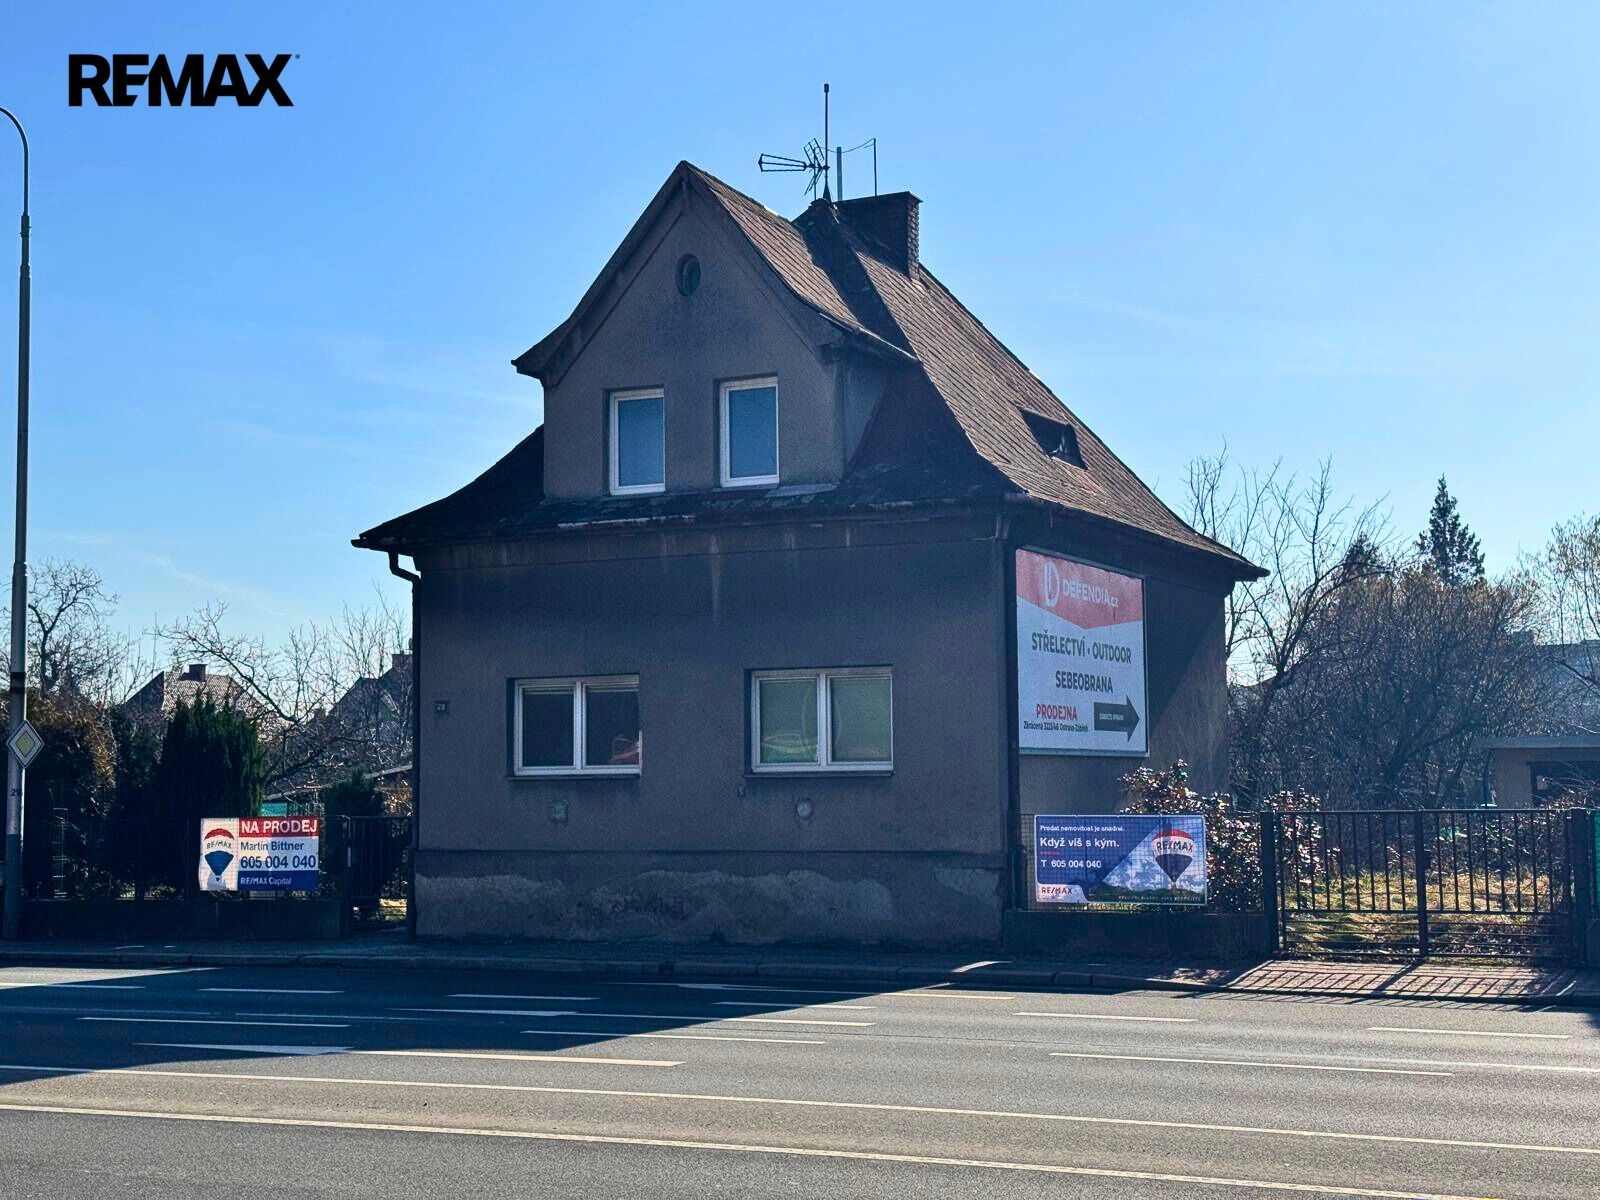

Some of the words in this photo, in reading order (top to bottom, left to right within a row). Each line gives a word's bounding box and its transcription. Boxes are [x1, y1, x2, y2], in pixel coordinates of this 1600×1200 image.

[1031, 630, 1086, 657] STŘELECTVÍ
[1092, 642, 1132, 664] OUTDOOR
[1055, 670, 1114, 694] SEBEOBRANA
[1036, 703, 1078, 721] PRODEJNA
[241, 820, 259, 834] NA
[263, 819, 318, 833] PRODEJ
[206, 839, 232, 850] RE/MAX
[240, 841, 268, 851] Martin
[271, 841, 304, 851] Bittner
[1040, 837, 1065, 849] Když
[1068, 837, 1083, 847] víš
[1085, 839, 1092, 847] s
[1094, 838, 1120, 849] kým.
[1156, 840, 1194, 853] RE/MAX
[240, 856, 262, 869] 605
[265, 856, 288, 869] 004
[292, 855, 316, 869] 040
[1041, 860, 1048, 868] T
[1051, 860, 1067, 868] 605
[1068, 860, 1084, 868] 004
[1086, 860, 1102, 869] 040
[240, 876, 267, 885] RE/MAX
[268, 876, 291, 887] Capital
[1041, 887, 1073, 895] RE/MAX
